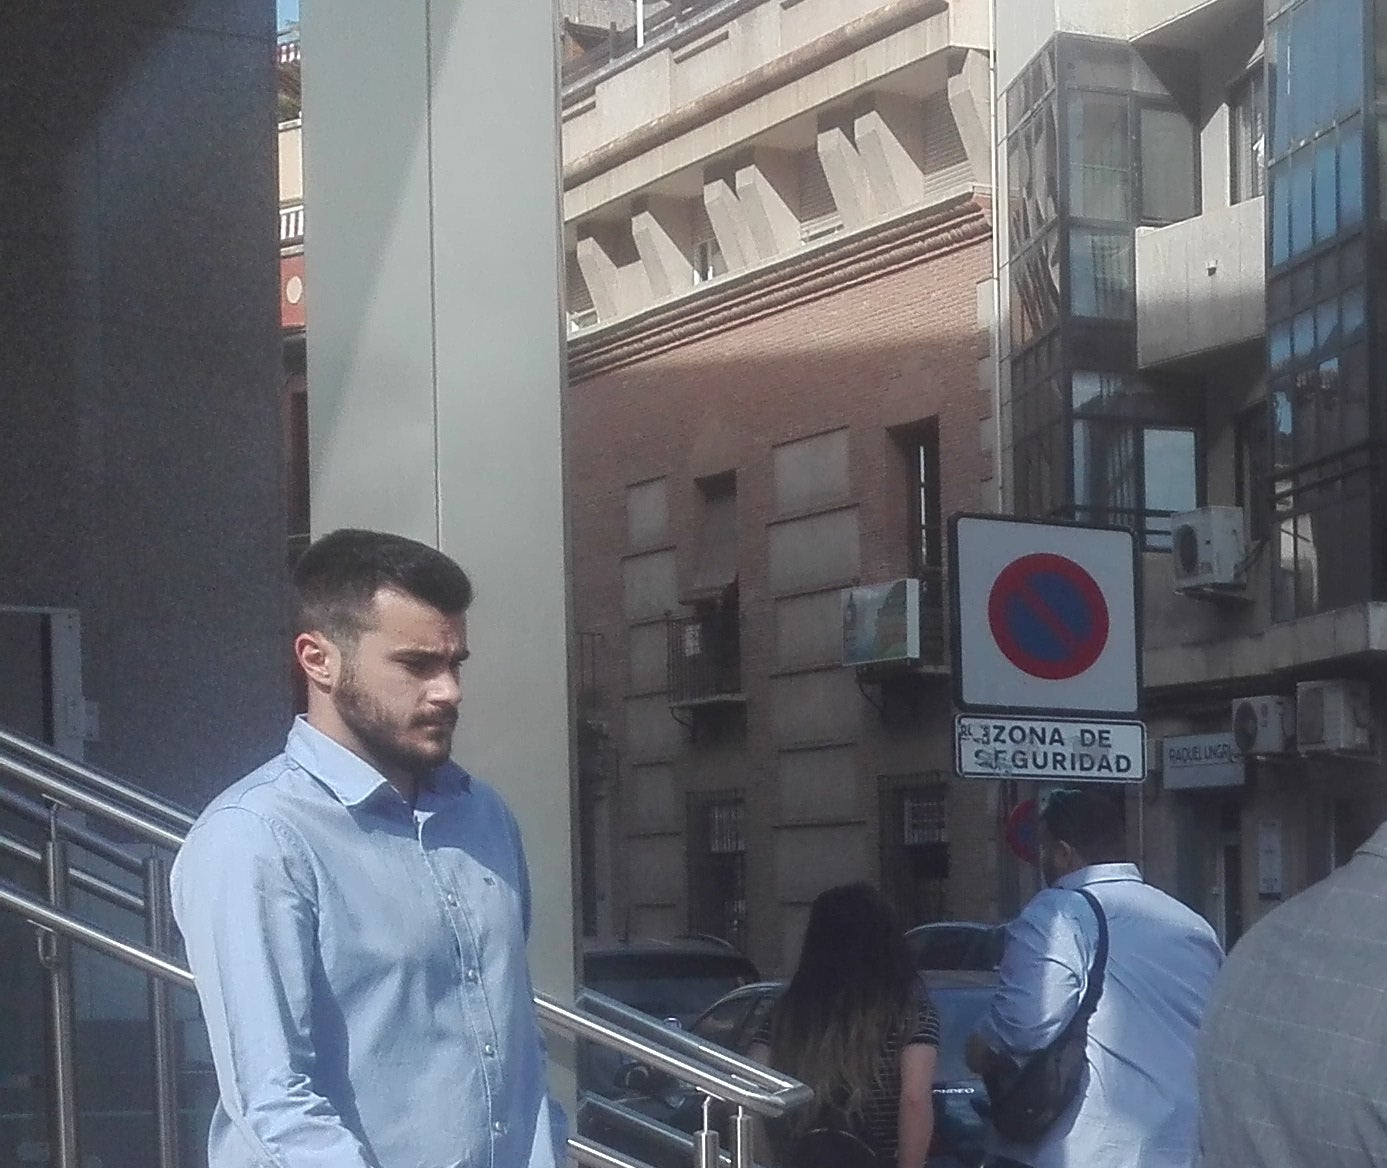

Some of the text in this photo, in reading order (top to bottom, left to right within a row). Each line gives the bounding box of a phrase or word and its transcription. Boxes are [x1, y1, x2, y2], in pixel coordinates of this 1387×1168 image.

[992, 725, 1065, 746] ZONA
[1080, 729, 1112, 748] DE
[974, 749, 1132, 773] SEGURIDAD
